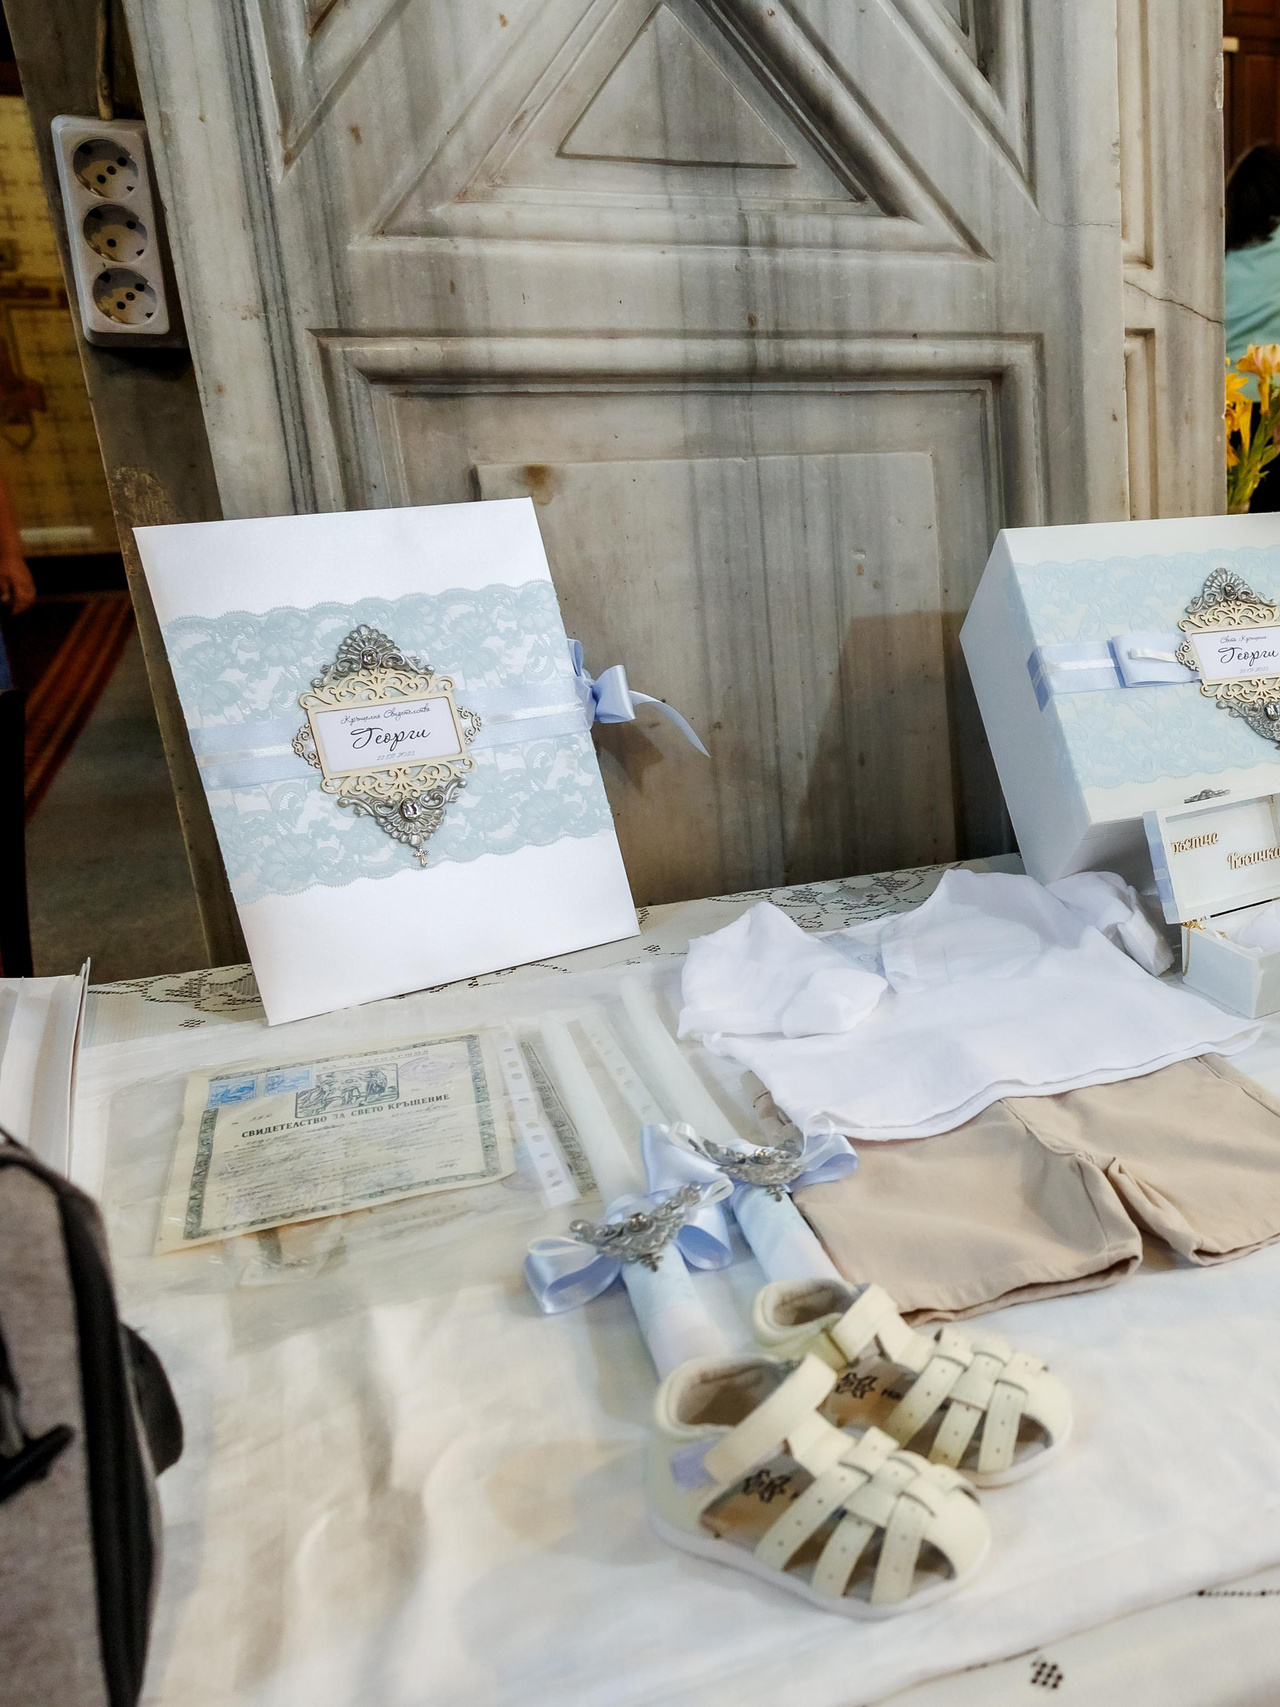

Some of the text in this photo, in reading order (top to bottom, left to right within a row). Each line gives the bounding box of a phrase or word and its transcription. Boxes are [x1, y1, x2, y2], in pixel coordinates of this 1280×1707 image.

[1218, 646, 1279, 667] Георги
[350, 727, 431, 752] Георги
[241, 1116, 328, 1139] СВИДЕТЕЛСТВО
[332, 1112, 346, 1121] ЗА
[351, 1105, 384, 1117] СВЕТО
[388, 1093, 450, 1110] КРЪЩЕНИЕ
